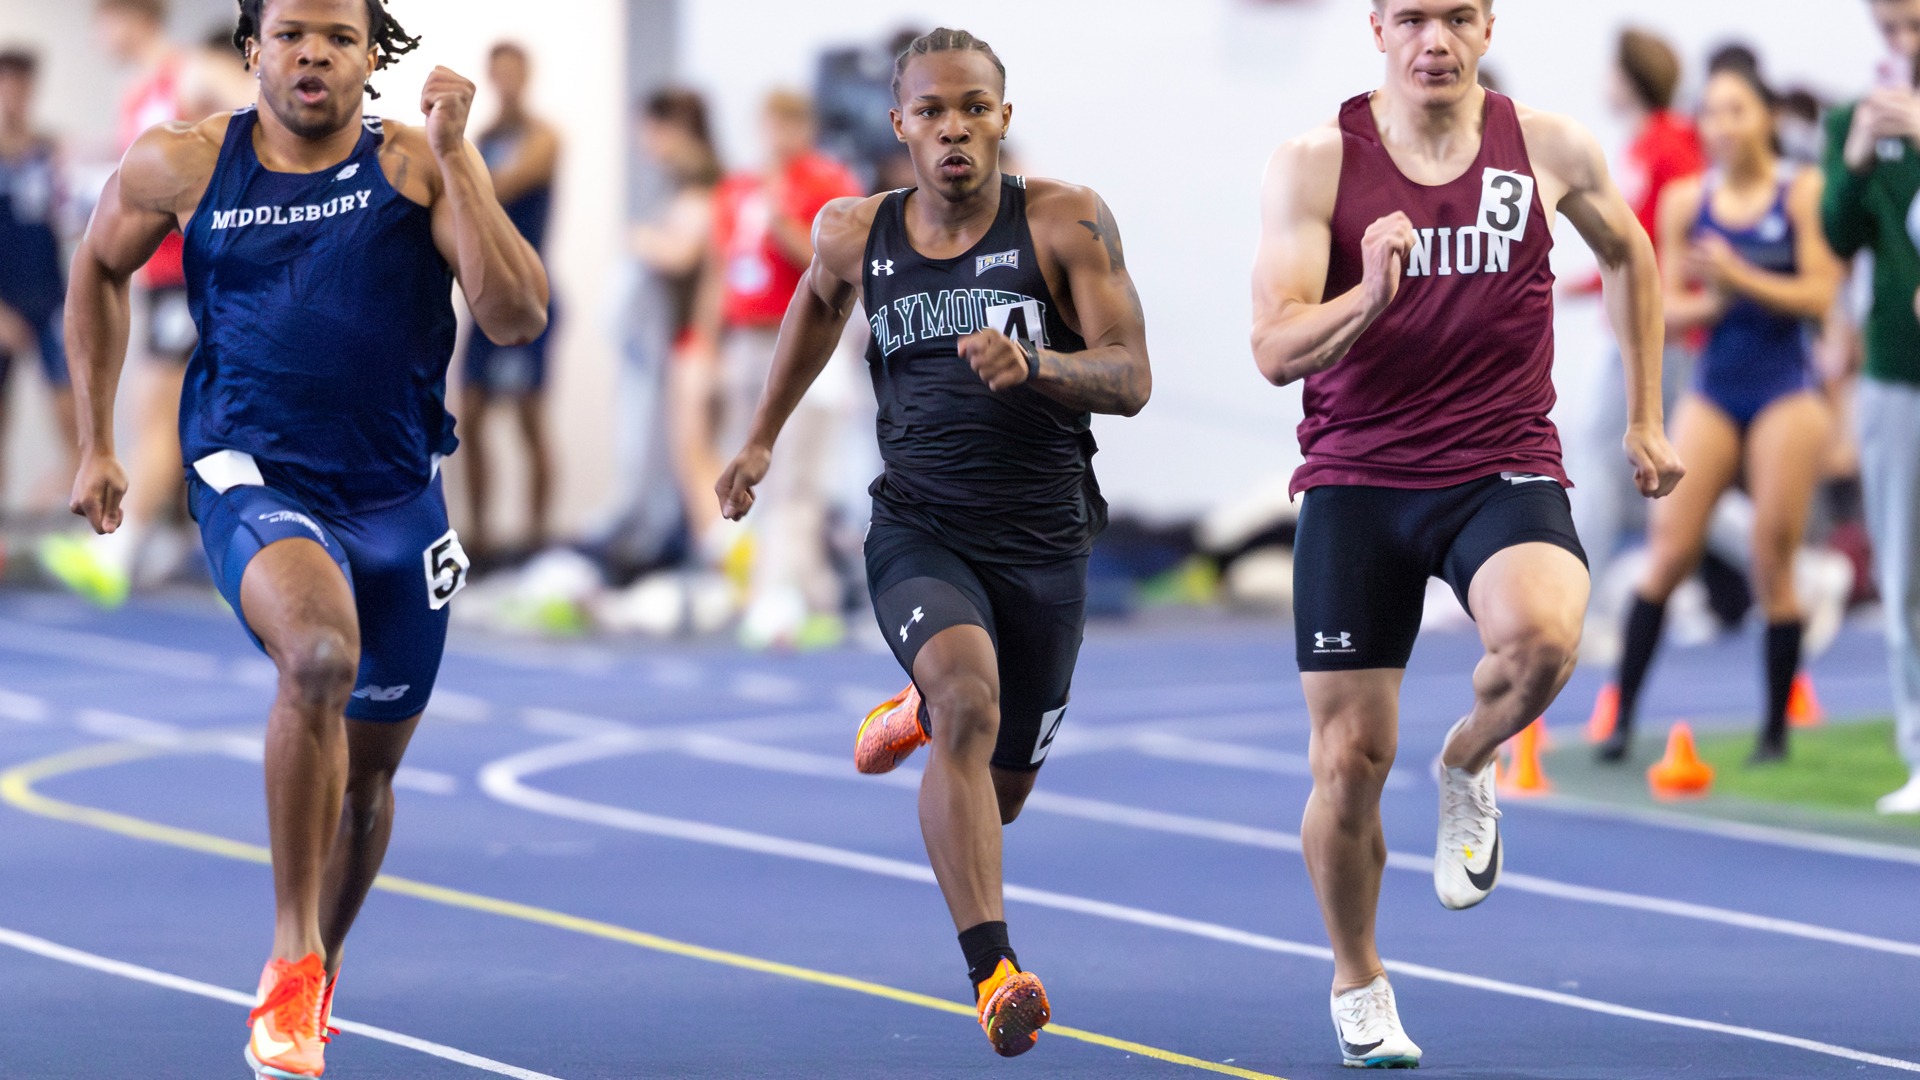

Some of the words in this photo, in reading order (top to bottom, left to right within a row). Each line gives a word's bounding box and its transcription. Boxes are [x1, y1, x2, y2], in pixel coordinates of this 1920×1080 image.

[211, 189, 372, 230] MIDDLEBURY
[1486, 175, 1523, 232] 3
[1406, 226, 1510, 277] NION
[870, 289, 1050, 357] PLYMOU
[431, 538, 462, 600] 5
